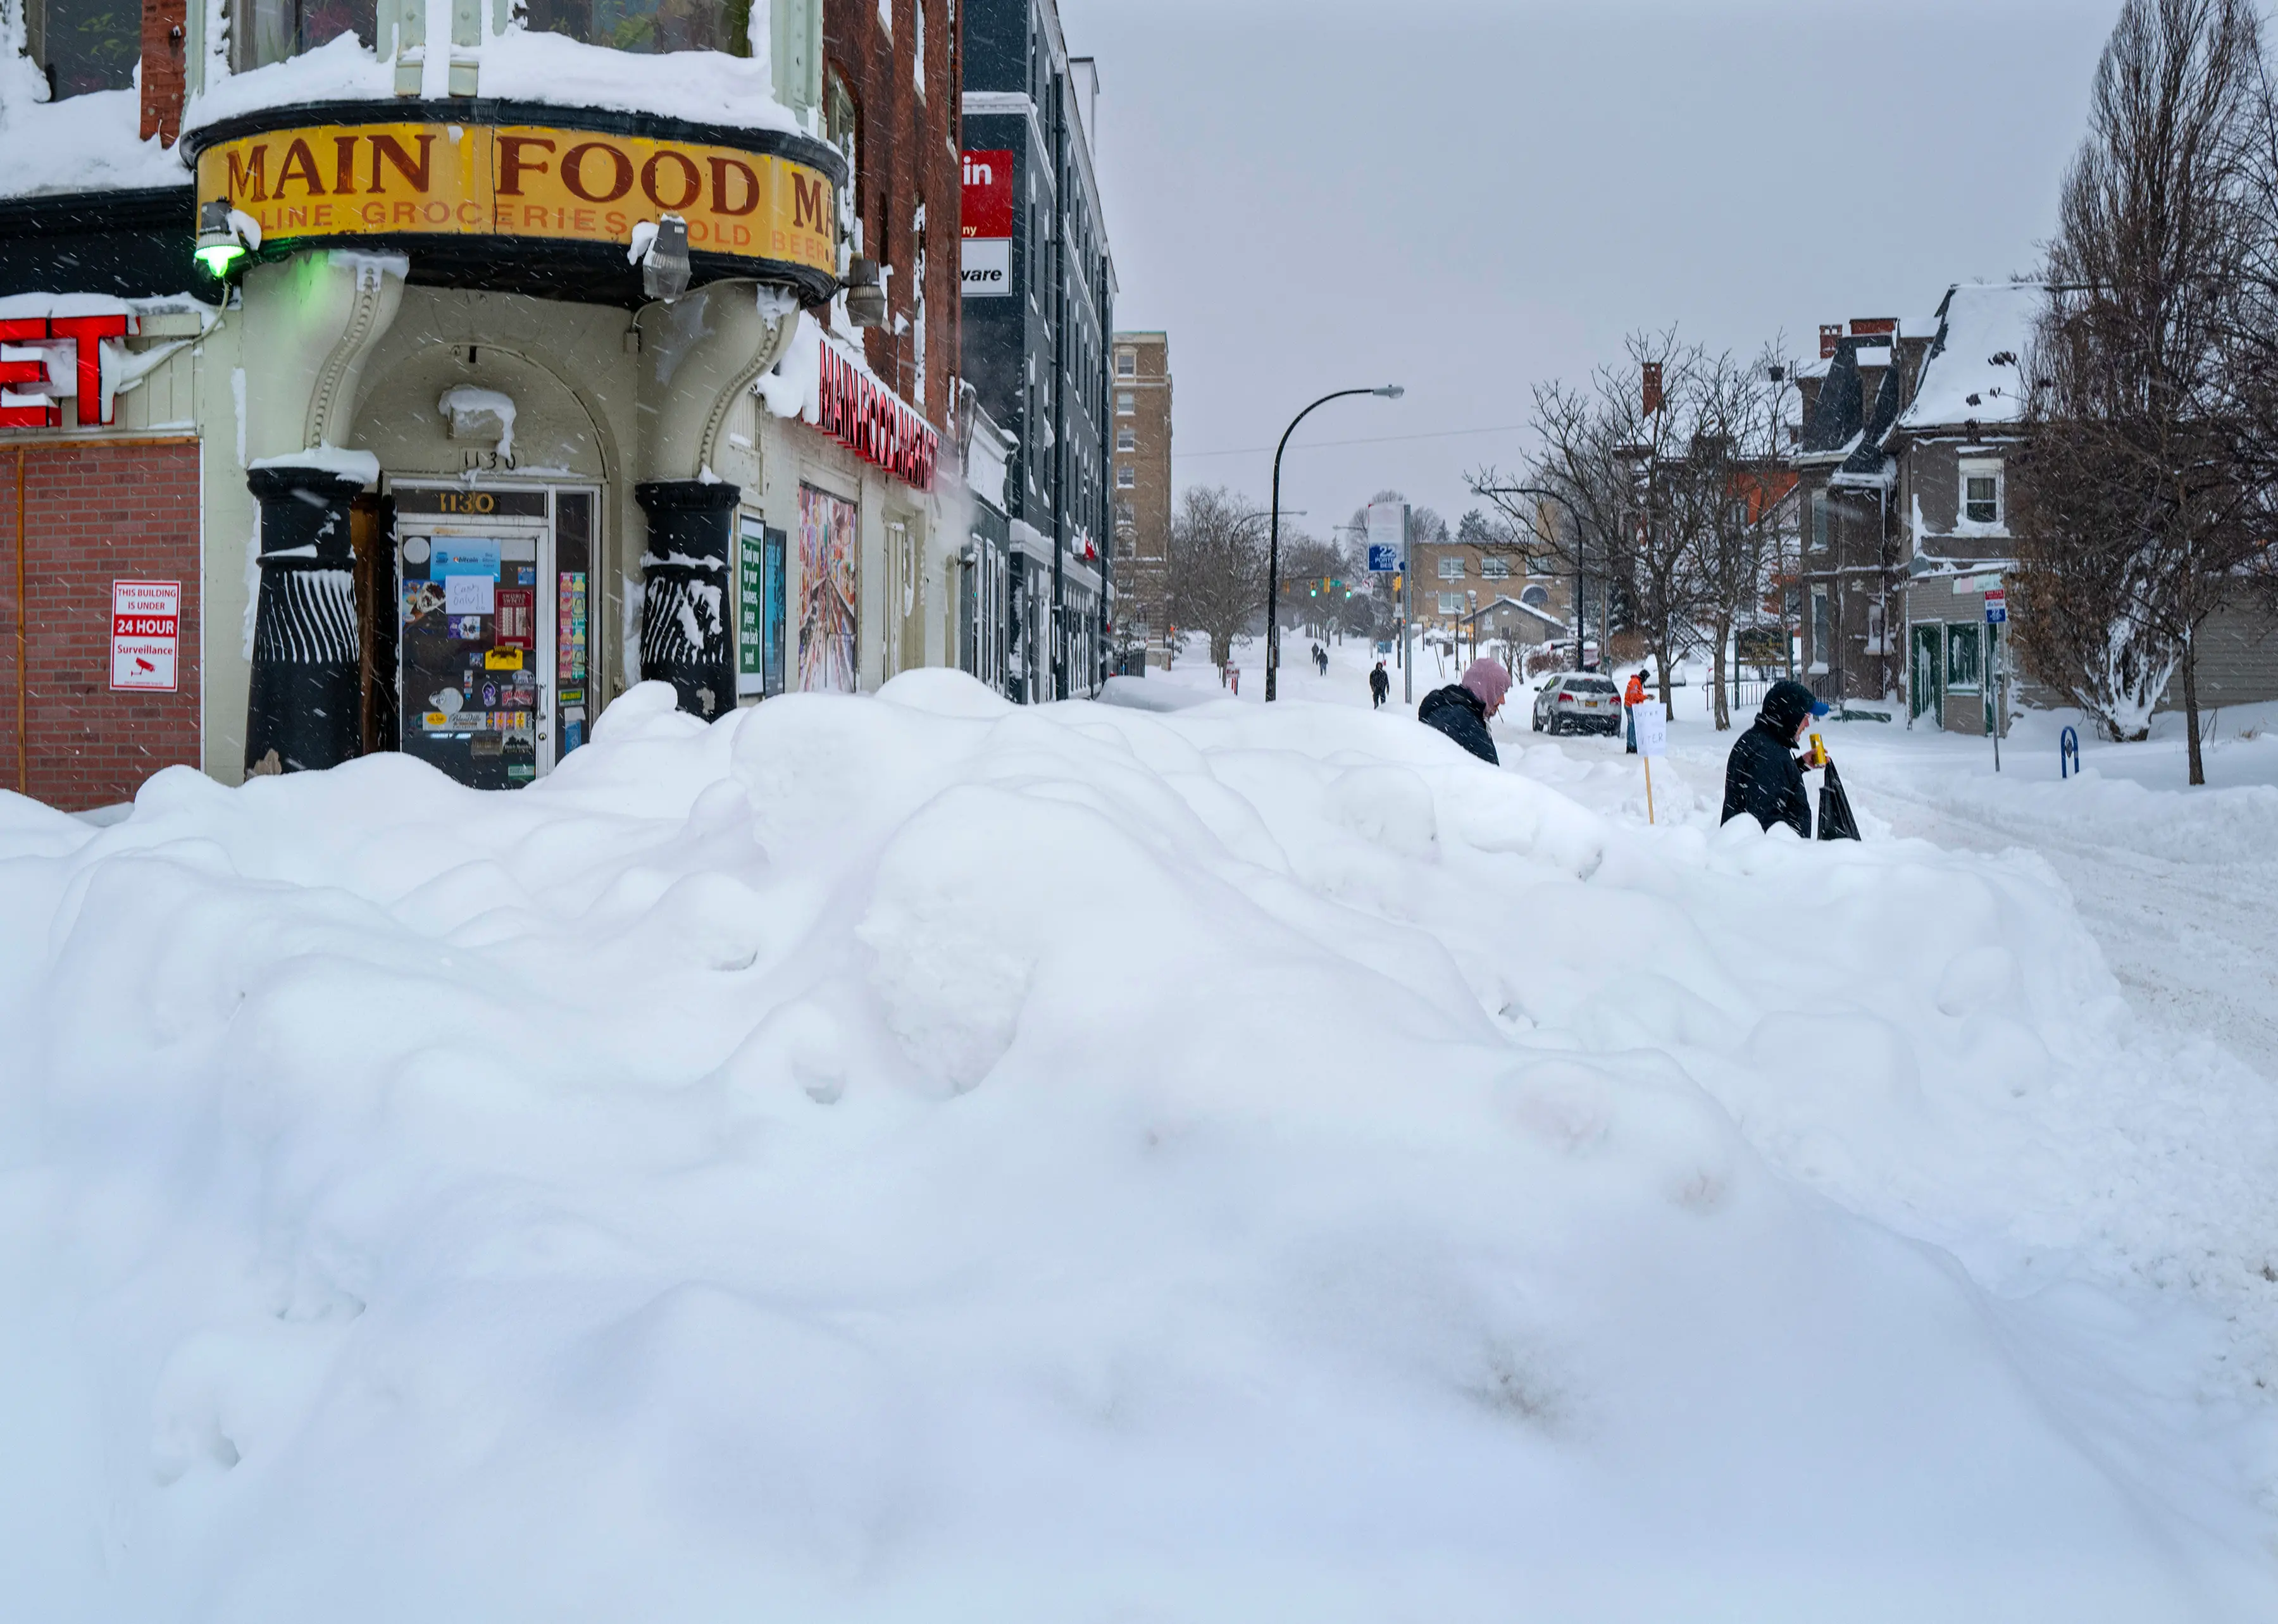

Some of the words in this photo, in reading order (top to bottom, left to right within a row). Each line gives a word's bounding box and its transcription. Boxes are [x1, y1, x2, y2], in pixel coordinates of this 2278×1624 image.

[227, 135, 437, 206] MAIN
[495, 135, 760, 216] FOOD
[963, 156, 992, 185] in
[261, 204, 333, 231] LINE
[361, 201, 628, 235] GROCERIES
[688, 220, 751, 247] OLD
[962, 225, 977, 237] ny
[819, 338, 858, 447] MAIN
[860, 373, 896, 468] FOOD
[464, 450, 516, 471] 1130
[440, 492, 494, 514] 1130
[742, 544, 752, 562] Thank
[454, 583, 480, 595] Cash
[748, 570, 757, 591] your
[118, 588, 136, 597] THIS
[137, 588, 177, 598] BUILDING
[128, 602, 135, 610] IS
[137, 602, 165, 611] UNDER
[117, 619, 134, 633] 24
[136, 619, 174, 635] HOUR
[744, 606, 755, 628] please
[741, 631, 750, 645] come
[750, 626, 759, 645] back
[117, 644, 173, 655] Surveillance
